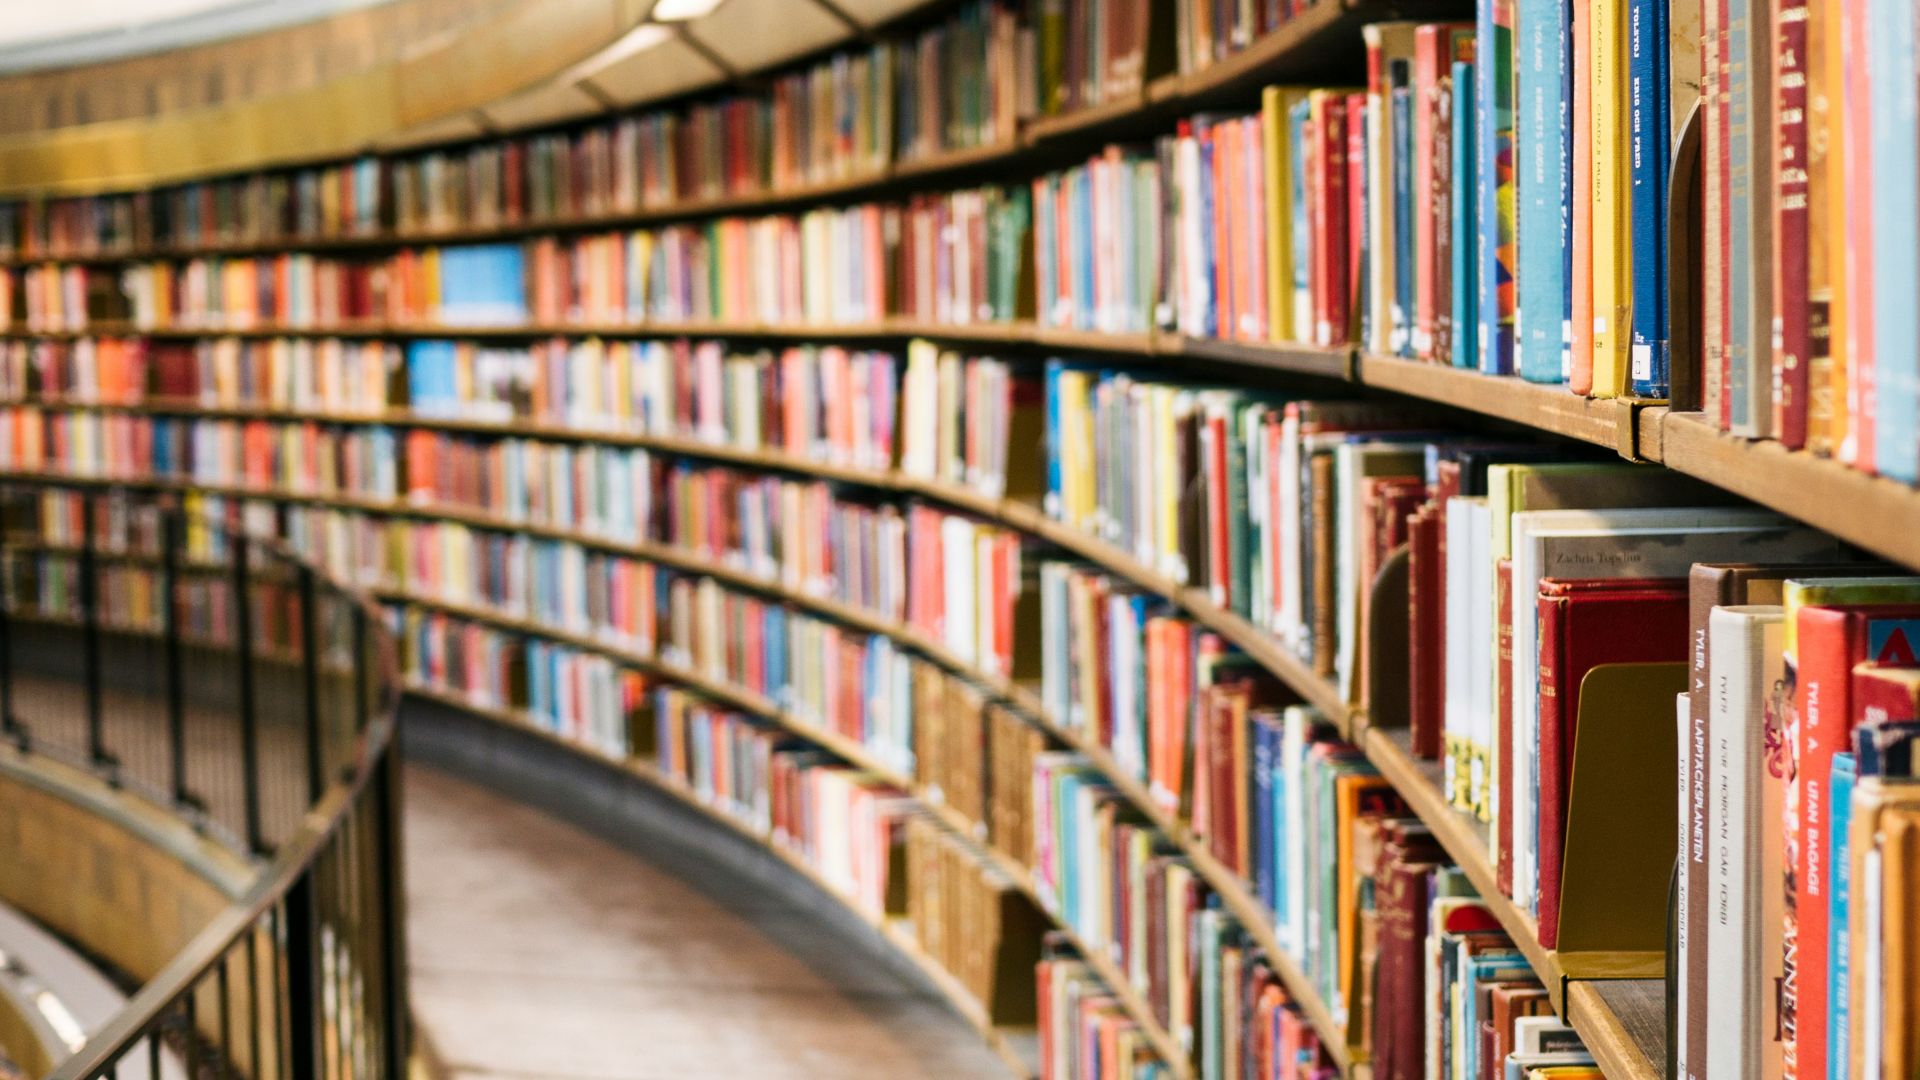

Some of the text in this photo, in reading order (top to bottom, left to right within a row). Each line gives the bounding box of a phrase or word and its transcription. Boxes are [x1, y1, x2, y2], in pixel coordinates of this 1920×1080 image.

[1556, 552, 1594, 564] Zachris
[1694, 628, 1705, 863] TYLER, A. LAPPTÄCKSPLANETEN
[1720, 775, 1728, 840] MORGAN
[1806, 681, 1819, 896] TYLER, A. UTAN BAGAGE
[1720, 846, 1728, 877] GÅR
